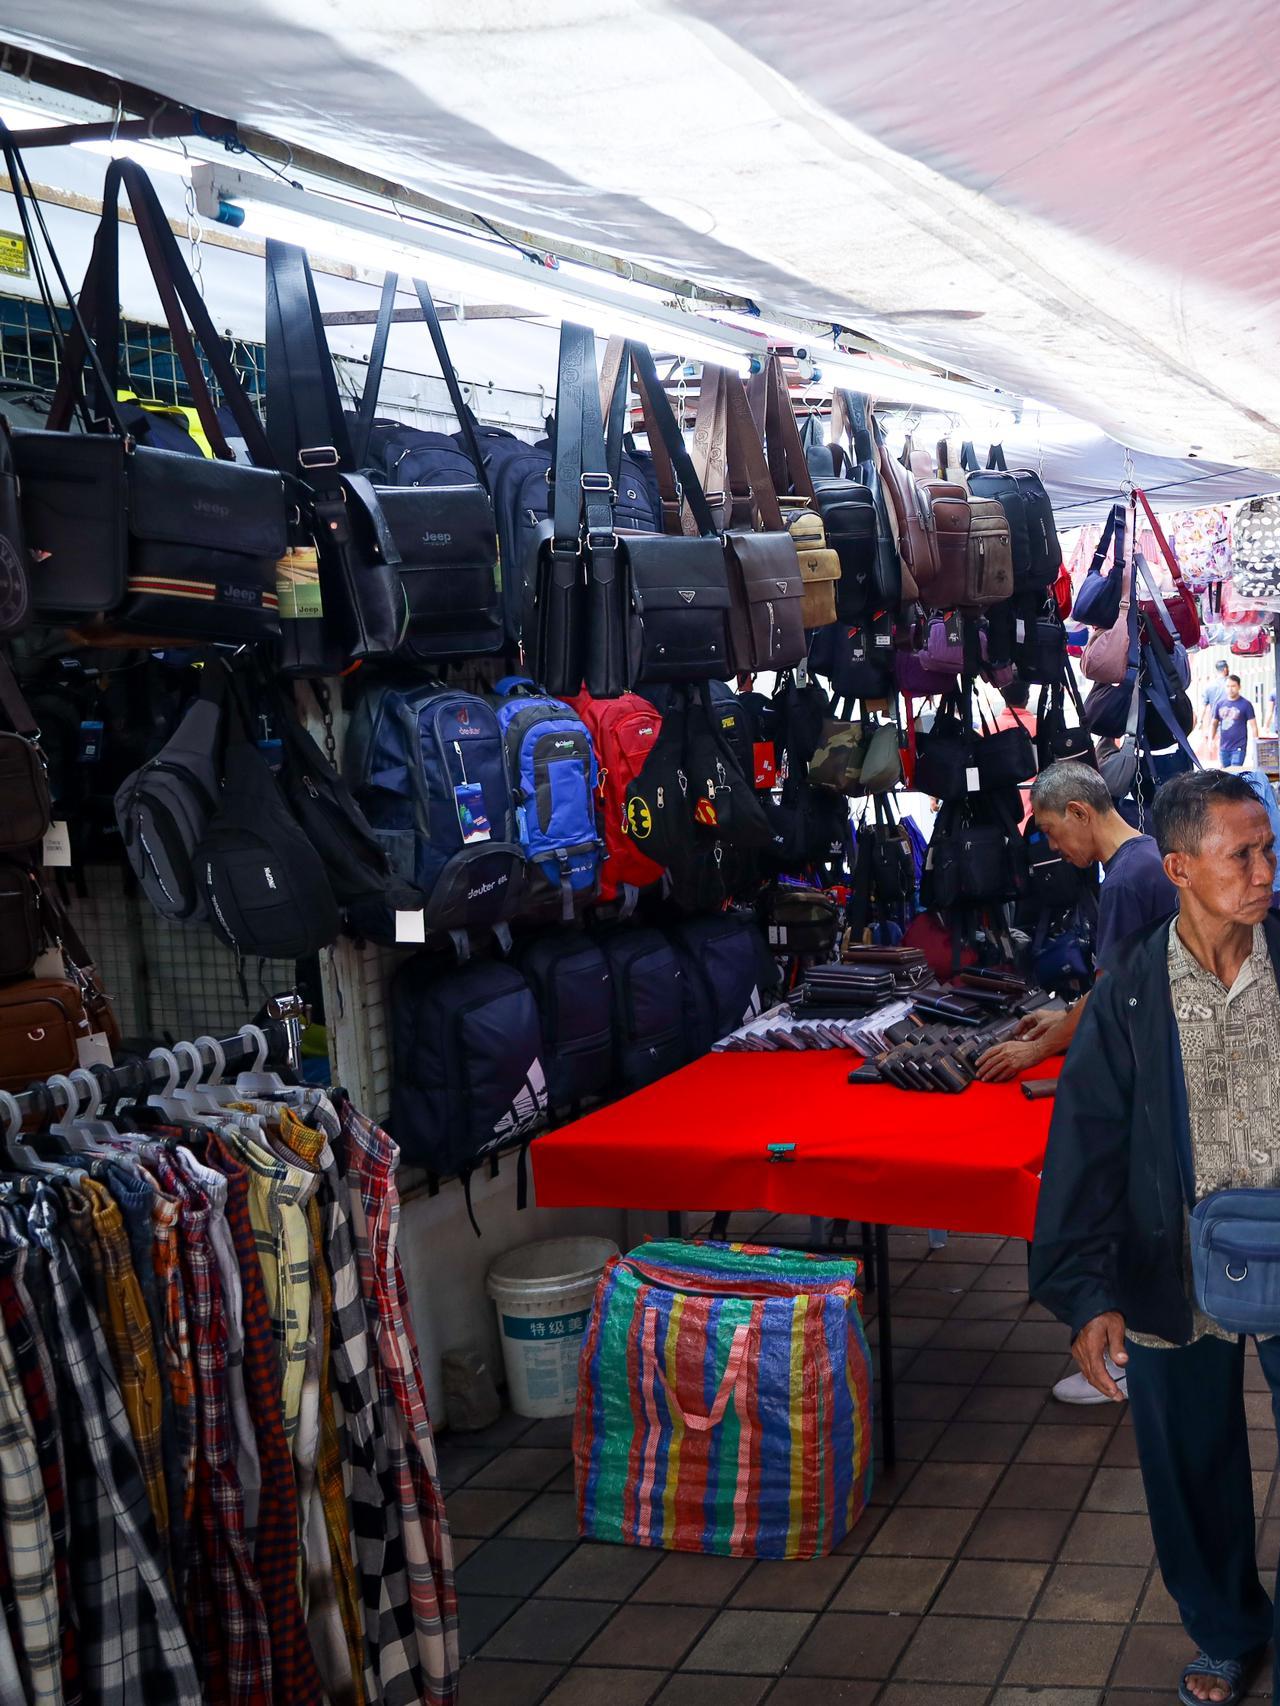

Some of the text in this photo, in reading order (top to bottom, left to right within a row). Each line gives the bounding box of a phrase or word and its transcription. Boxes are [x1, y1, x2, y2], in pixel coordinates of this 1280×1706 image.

[193, 500, 230, 517] Jeep
[422, 531, 452, 544] Jeep
[224, 584, 258, 601] Jeep
[299, 605, 319, 614] Jeep
